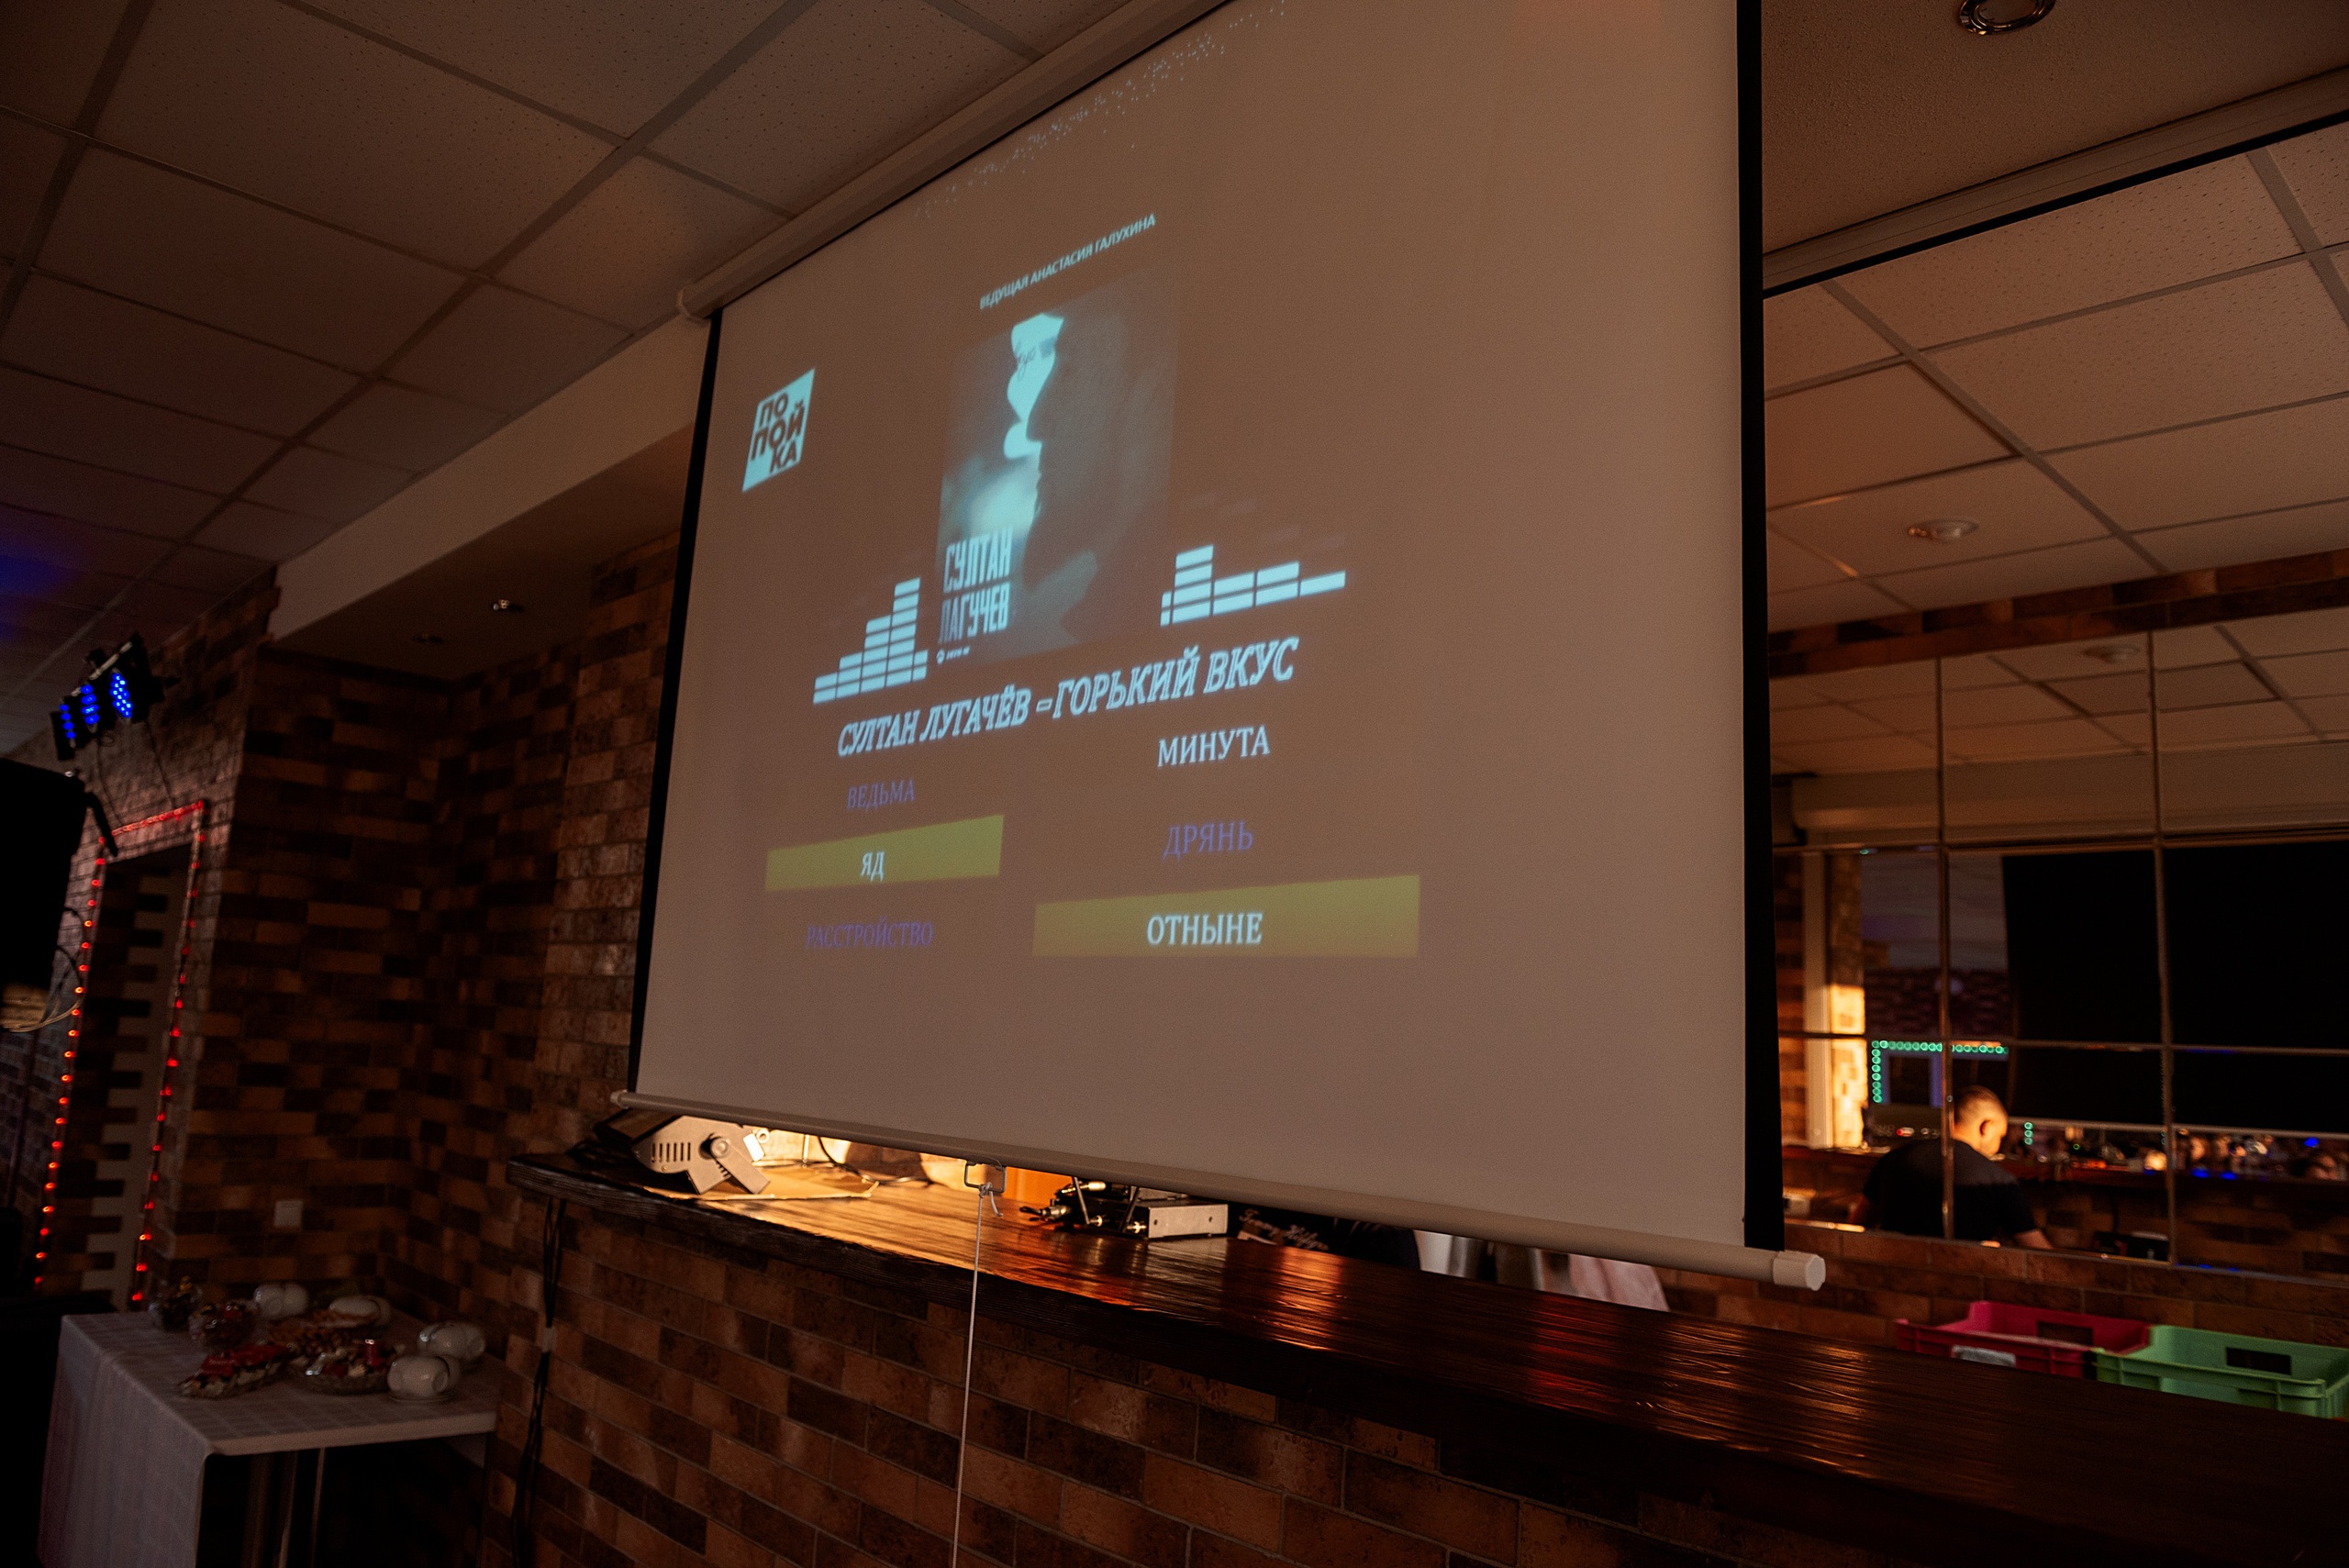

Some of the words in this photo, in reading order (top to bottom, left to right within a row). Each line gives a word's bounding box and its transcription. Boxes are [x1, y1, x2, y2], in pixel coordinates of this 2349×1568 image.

[980, 274, 1029, 309] ВЕДУЩАЯ
[1030, 243, 1093, 284] АНАСТАСИЯ
[1095, 213, 1156, 253] ГАЛУХИНА
[751, 398, 805, 461] ПОЙ
[759, 392, 788, 428] ПО
[769, 439, 797, 473] КА
[942, 526, 1013, 594] СУЛТАН
[838, 709, 920, 757] СУЛТАН
[919, 684, 1032, 742] ЛУГАЧЁВ
[1203, 636, 1299, 694] ВКУС
[1158, 724, 1271, 768] МИНУТА
[847, 778, 916, 812] ВЕДЬМА
[1162, 820, 1254, 862] ДРЯНЬ
[861, 850, 885, 883] ЯД
[806, 916, 934, 949] РАССТРОЙСТВО
[1147, 911, 1264, 946] ОТНЫНЕ
